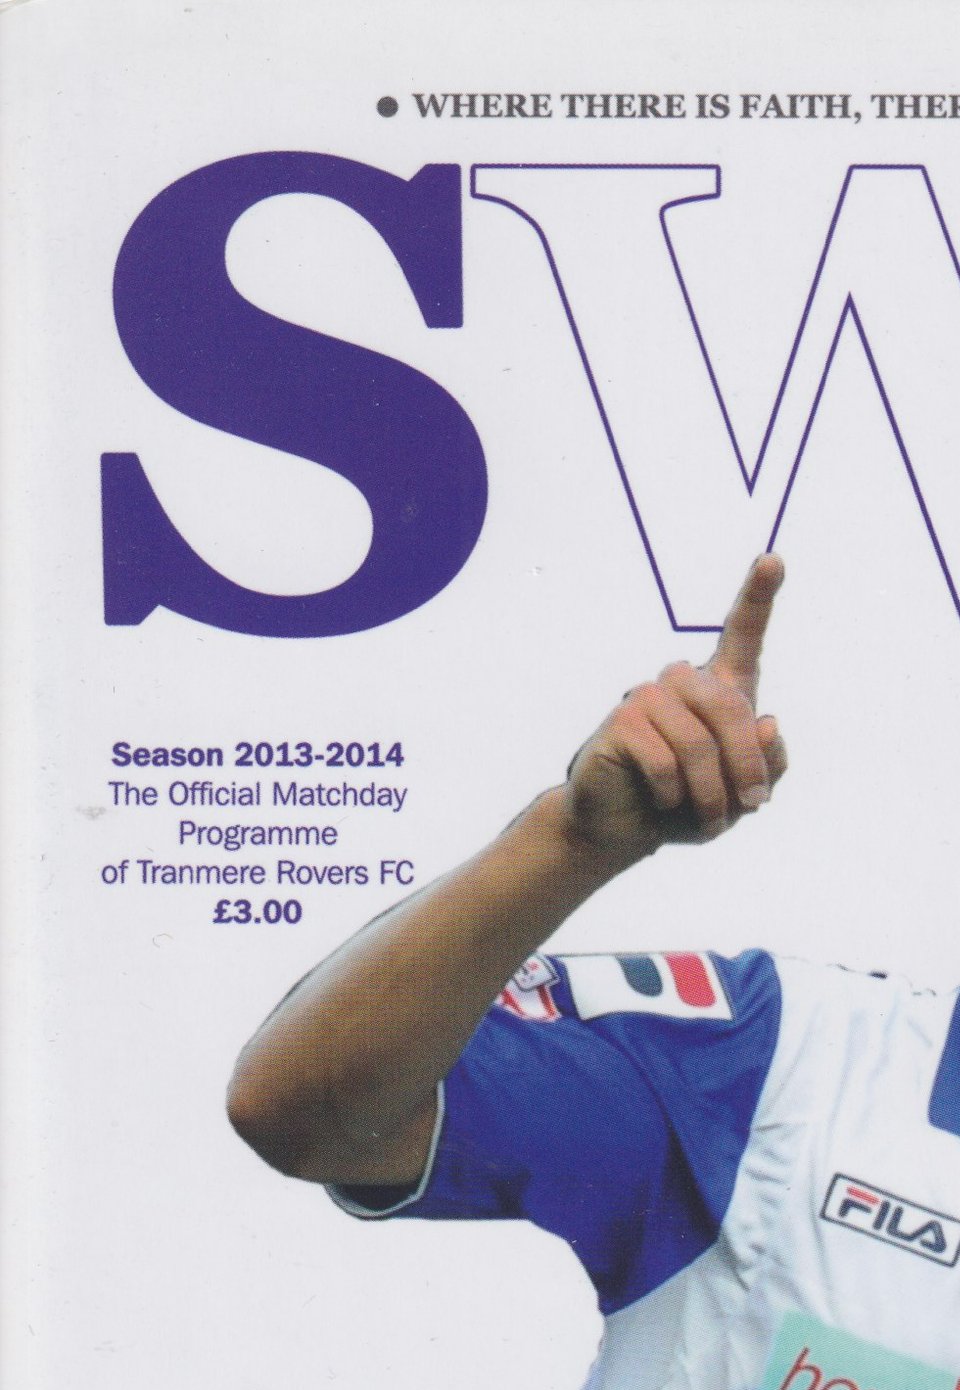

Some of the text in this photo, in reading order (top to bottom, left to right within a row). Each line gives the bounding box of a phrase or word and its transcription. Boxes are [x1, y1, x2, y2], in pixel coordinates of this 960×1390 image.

[413, 94, 552, 118] WHERE
[561, 94, 685, 118] THERE
[696, 94, 729, 118] IS
[741, 95, 861, 123] FAITH,
[112, 742, 404, 767] Season 2013-2014
[109, 781, 407, 812] The Official Matchday
[180, 821, 337, 850] Programme
[102, 860, 413, 885] of Tranmere Rovers FC
[213, 899, 302, 924] £3.00
[837, 1186, 948, 1255] FILA
